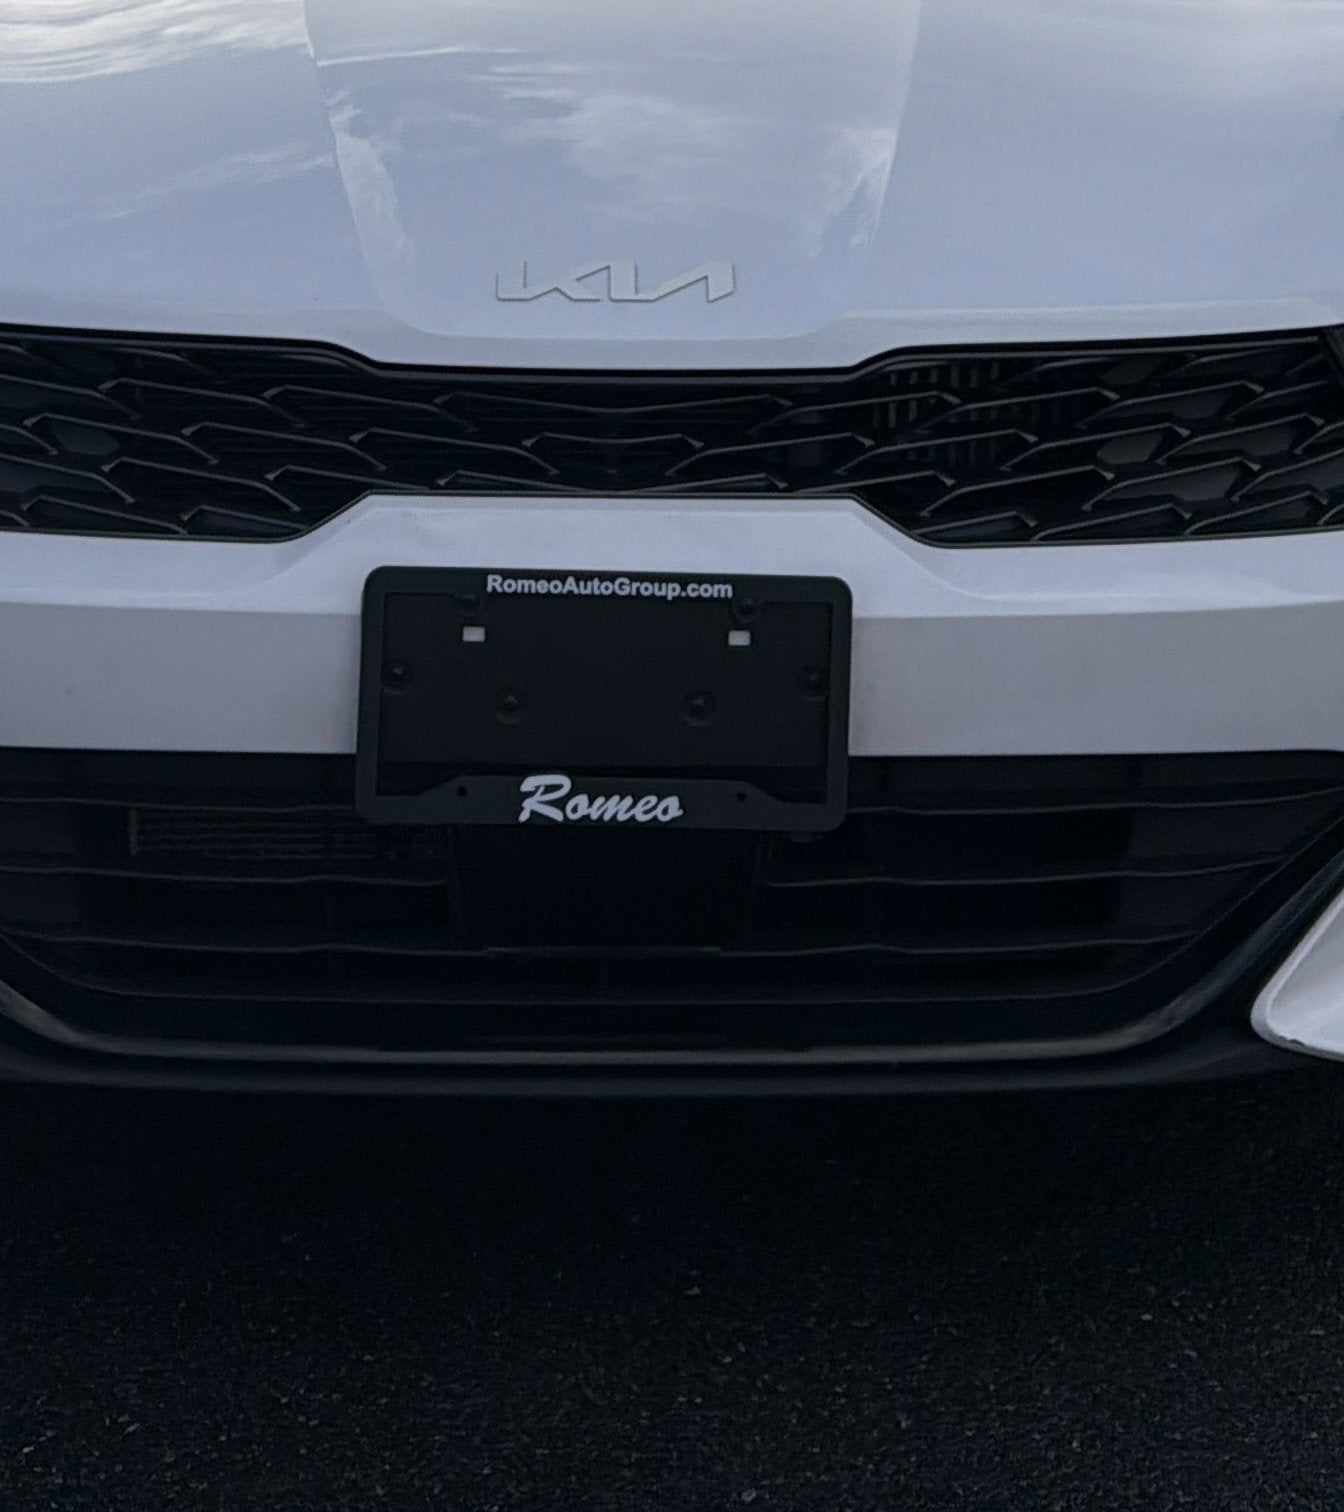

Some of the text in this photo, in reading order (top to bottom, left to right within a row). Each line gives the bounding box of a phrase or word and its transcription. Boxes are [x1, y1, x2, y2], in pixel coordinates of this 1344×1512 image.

[495, 258, 737, 304] KIA
[486, 574, 734, 601] RomeoAutoGroup.com
[518, 774, 684, 824] Romeo
